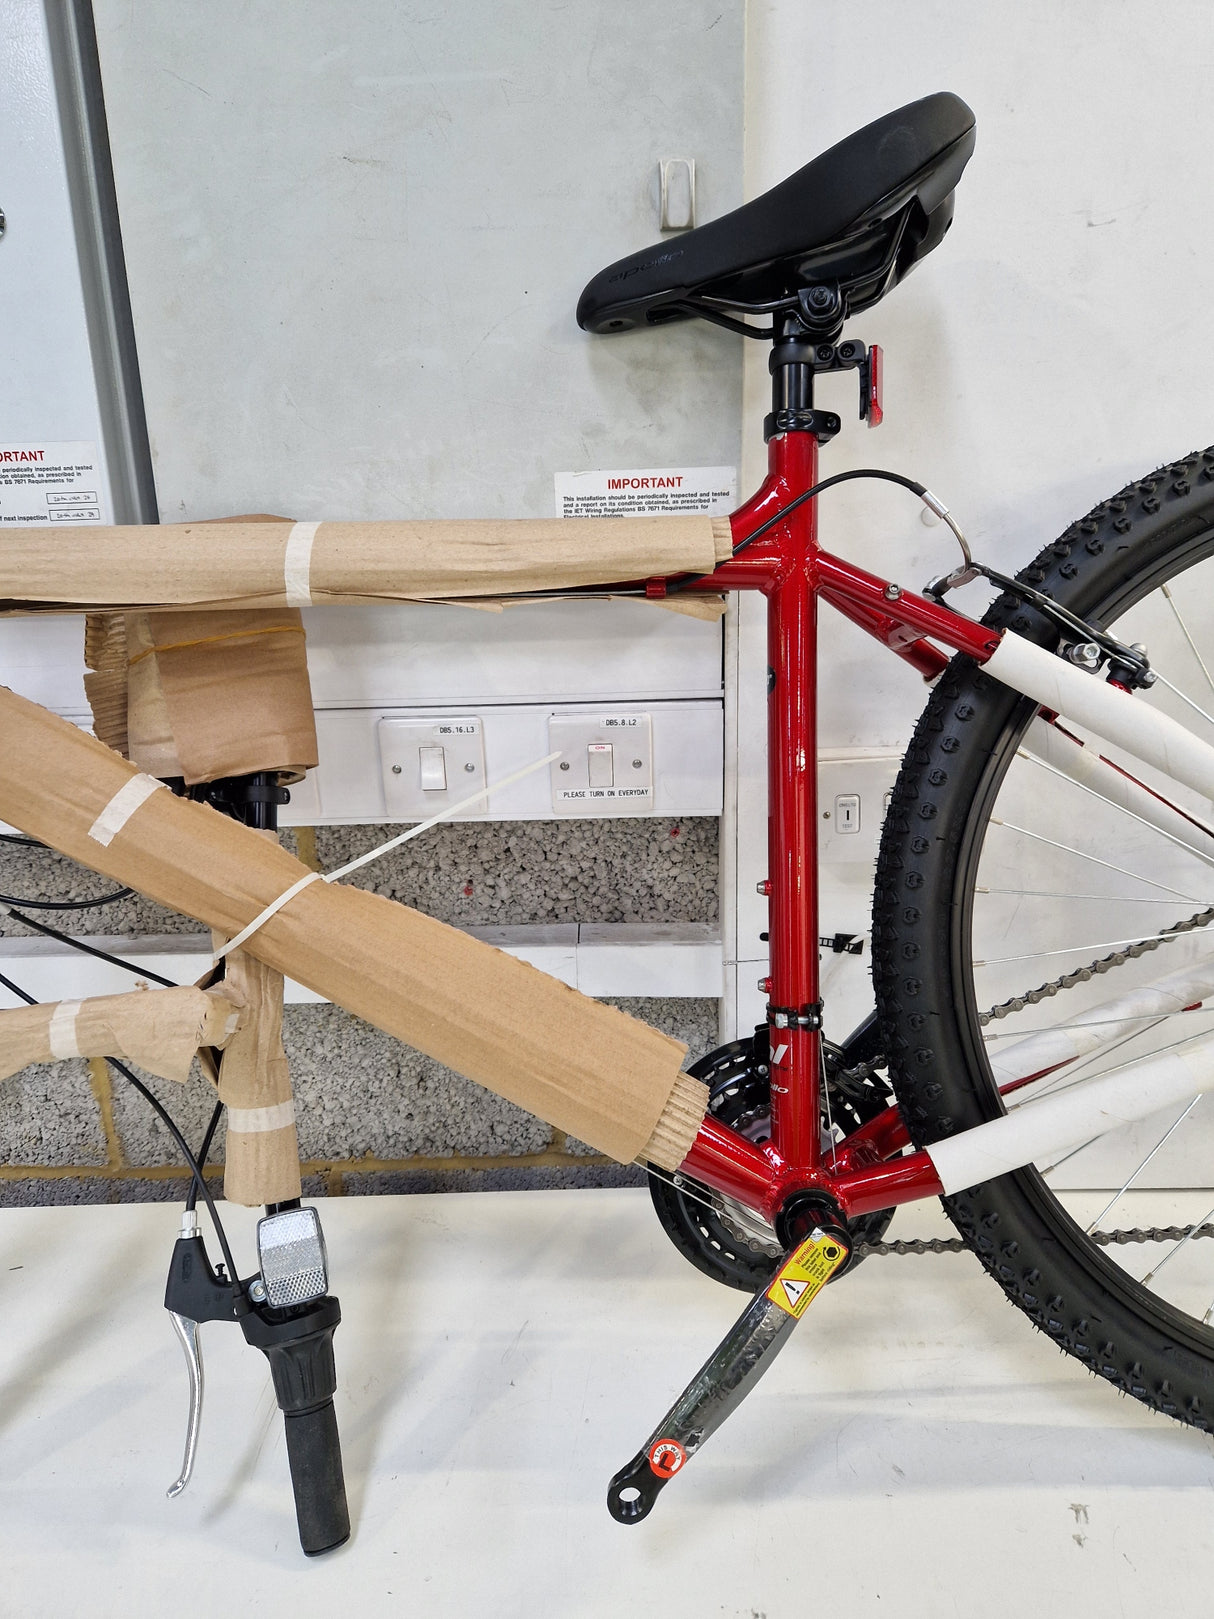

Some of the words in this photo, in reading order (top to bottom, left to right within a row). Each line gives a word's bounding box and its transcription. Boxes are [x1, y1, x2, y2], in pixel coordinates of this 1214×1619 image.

[607, 476, 683, 489] IMPORTANT
[440, 726, 475, 734] DB5.16.L3
[794, 1240, 816, 1265] Warning!
[654, 1444, 667, 1457] THIS
[670, 1446, 681, 1460] WAY
[658, 1452, 670, 1471] L
